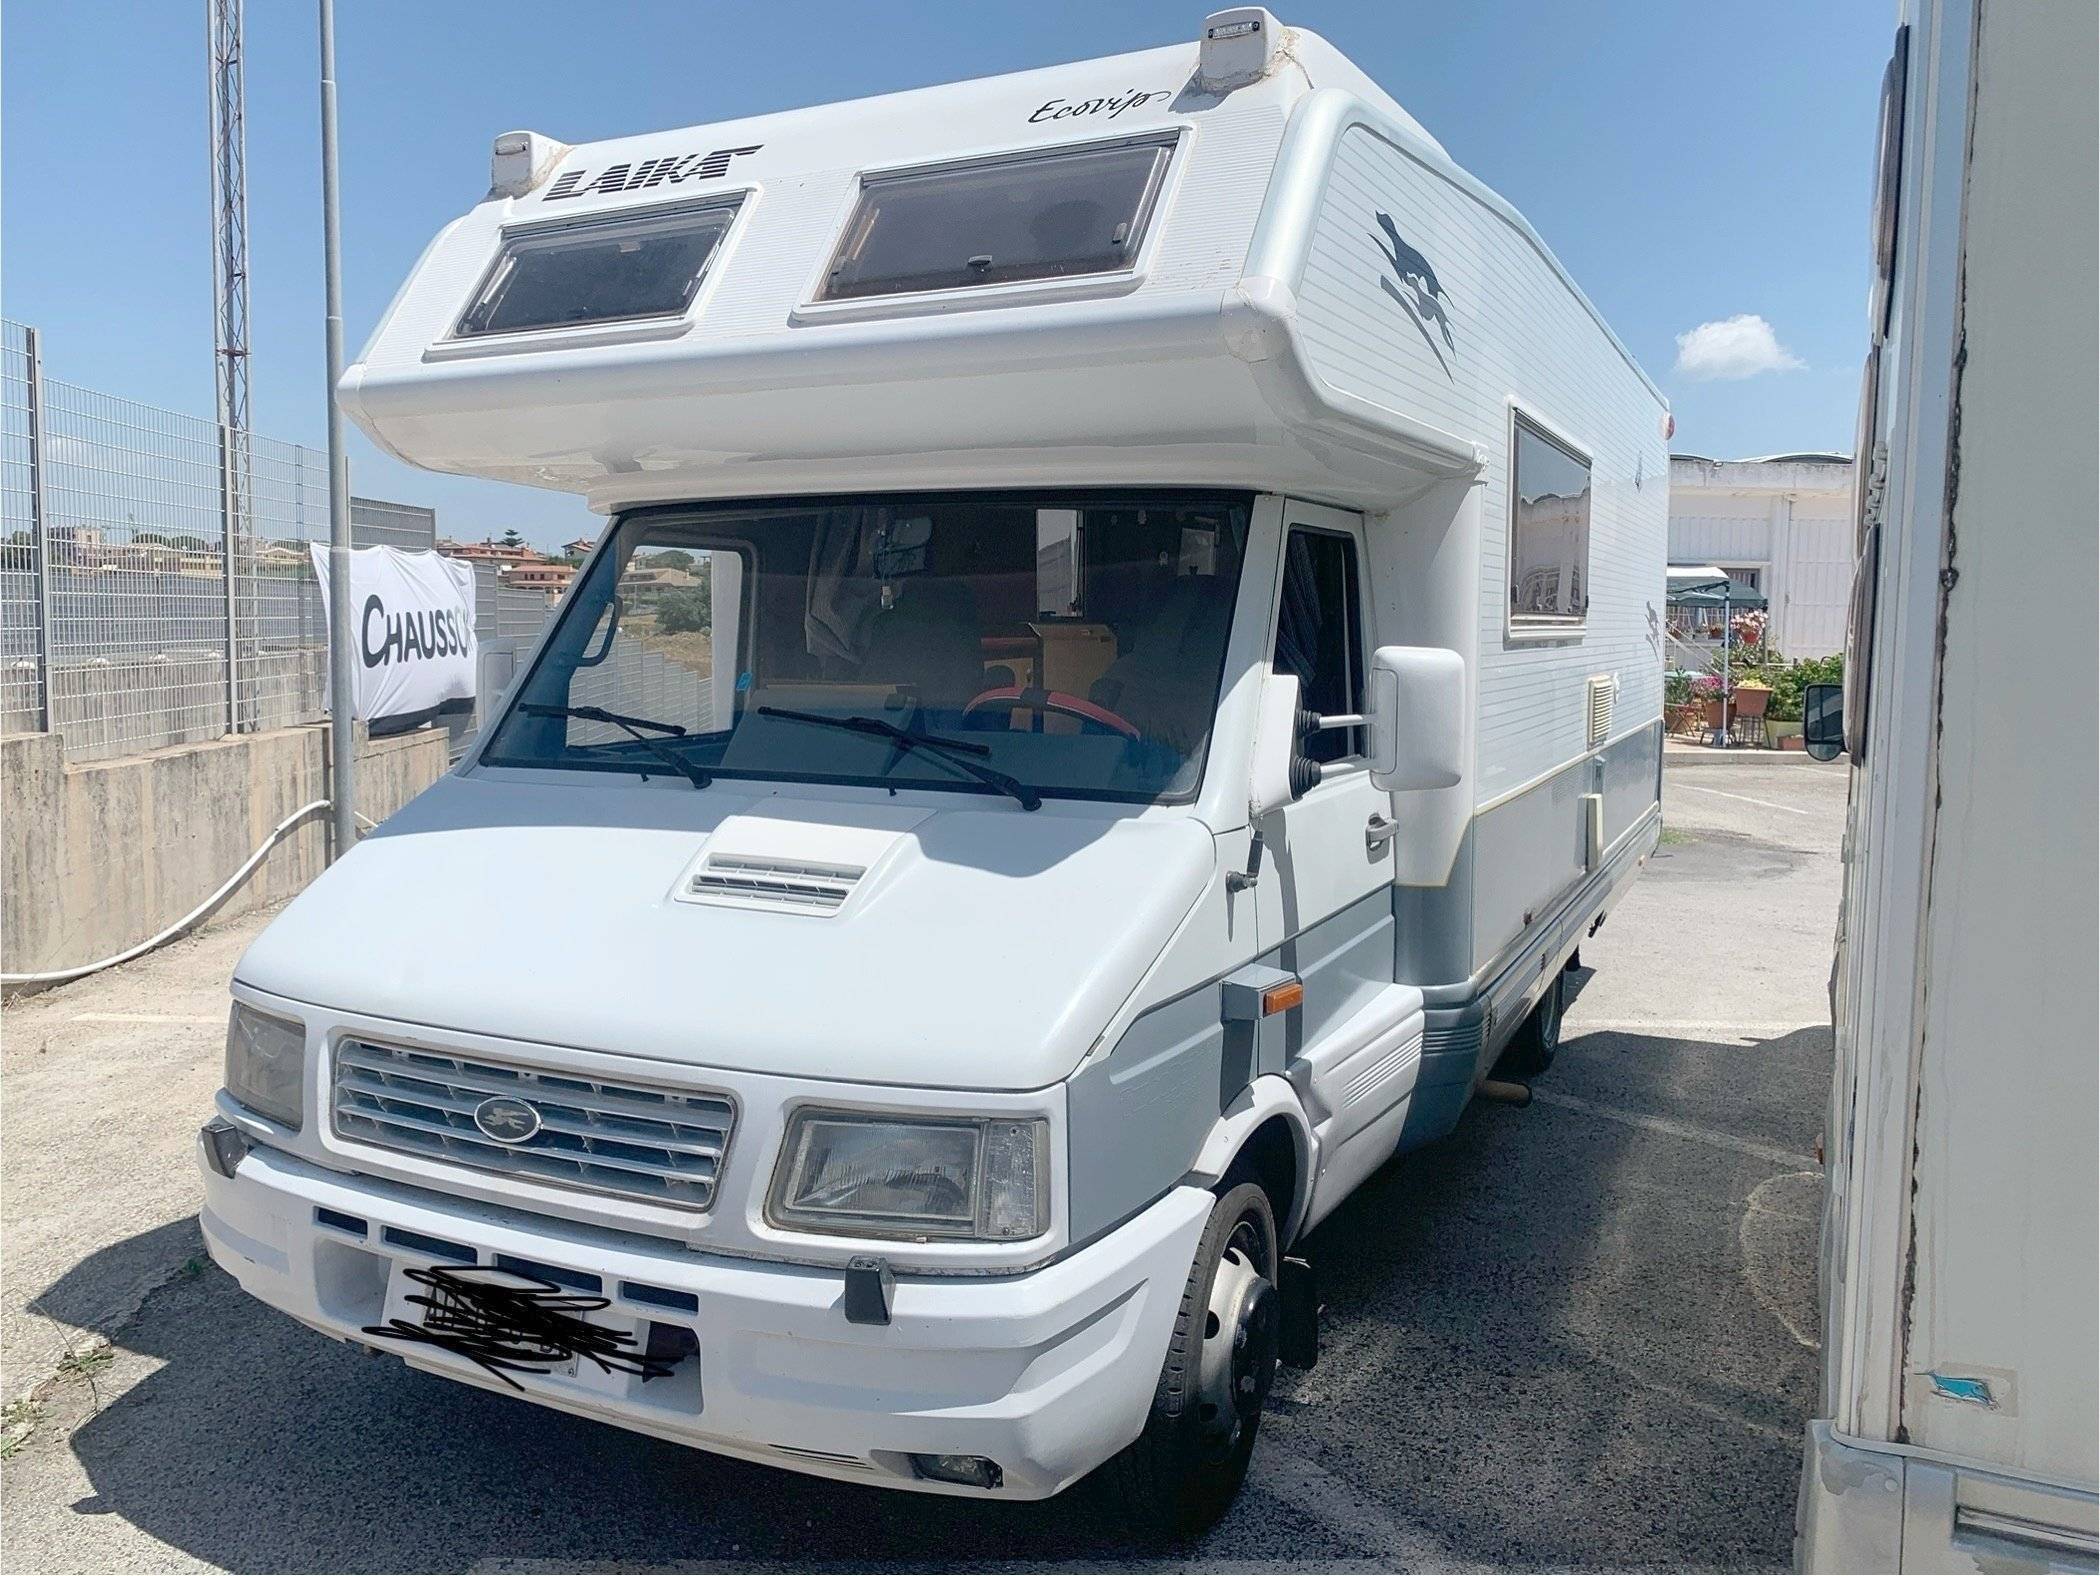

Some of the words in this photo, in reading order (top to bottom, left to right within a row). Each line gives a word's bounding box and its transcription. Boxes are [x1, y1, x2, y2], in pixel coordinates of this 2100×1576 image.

[1027, 87, 1171, 124] Ecovip
[542, 144, 764, 202] LAIKA
[361, 593, 470, 669] CHAUSSO
